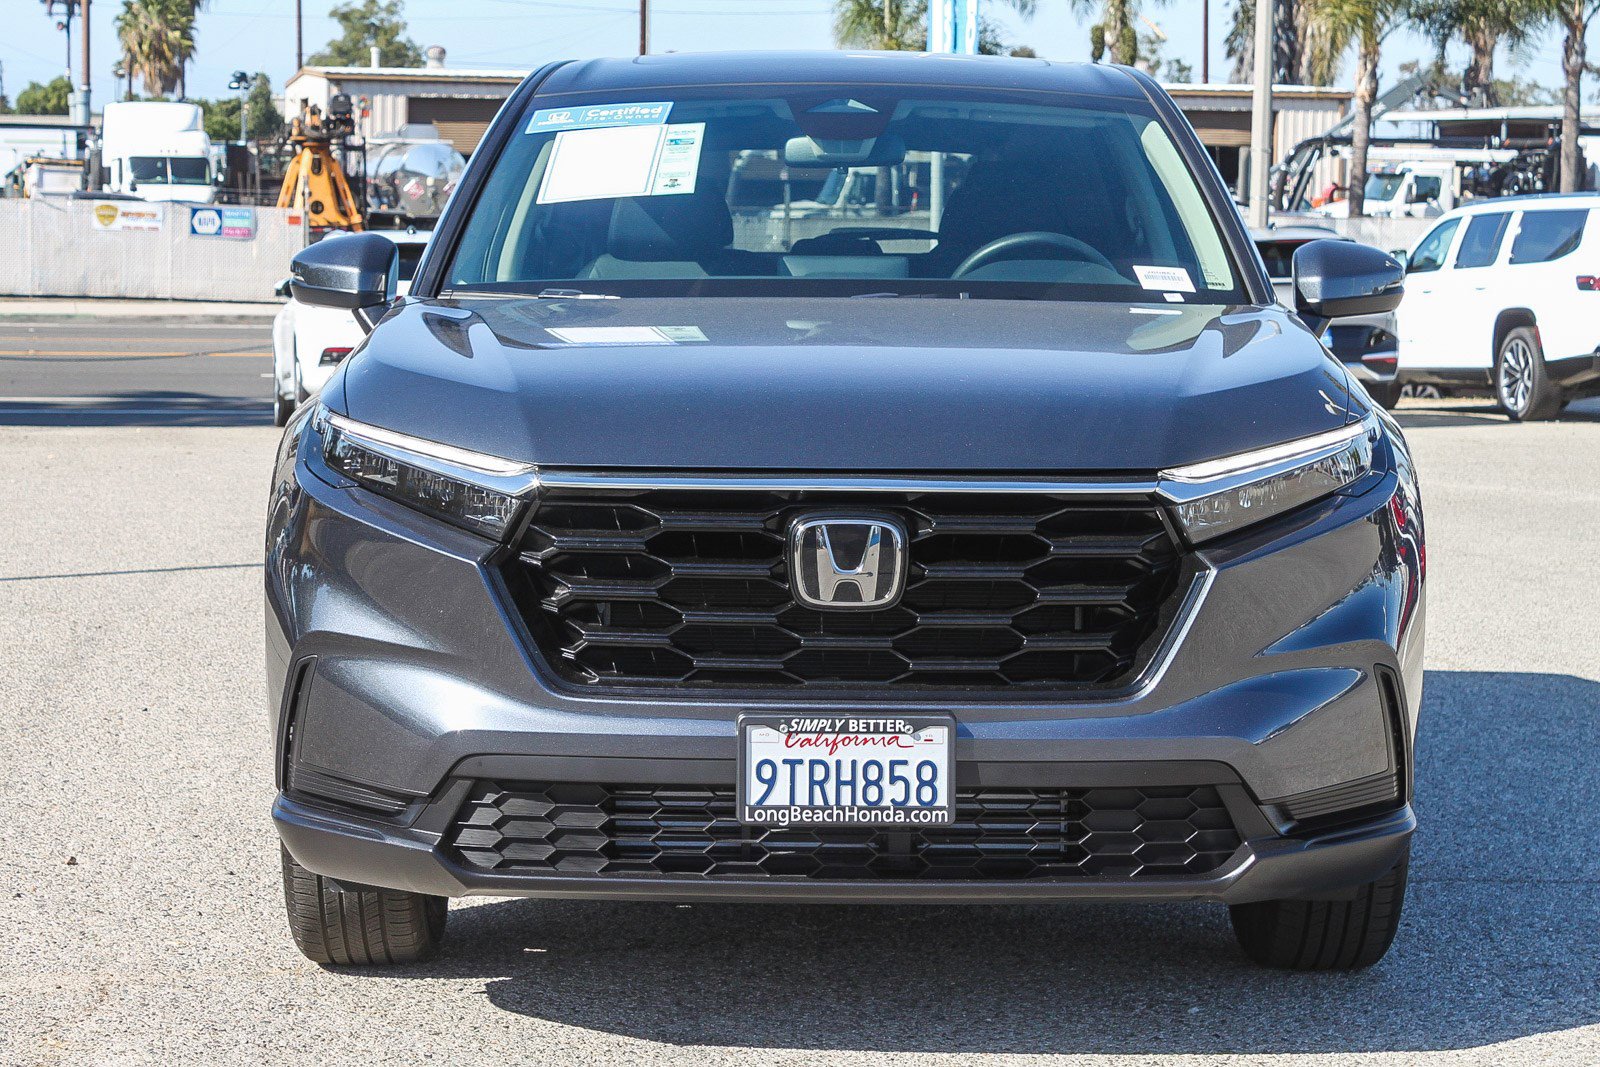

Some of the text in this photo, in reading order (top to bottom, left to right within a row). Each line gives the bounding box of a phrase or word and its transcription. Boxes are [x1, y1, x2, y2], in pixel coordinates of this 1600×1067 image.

[584, 113, 660, 121] Pre-Owned
[587, 105, 663, 117] Certified
[788, 718, 905, 733] SIMPLY BETTER
[784, 732, 914, 756] California
[754, 758, 938, 806] 9TRH858
[744, 805, 949, 825] LongBeachHonda.com
